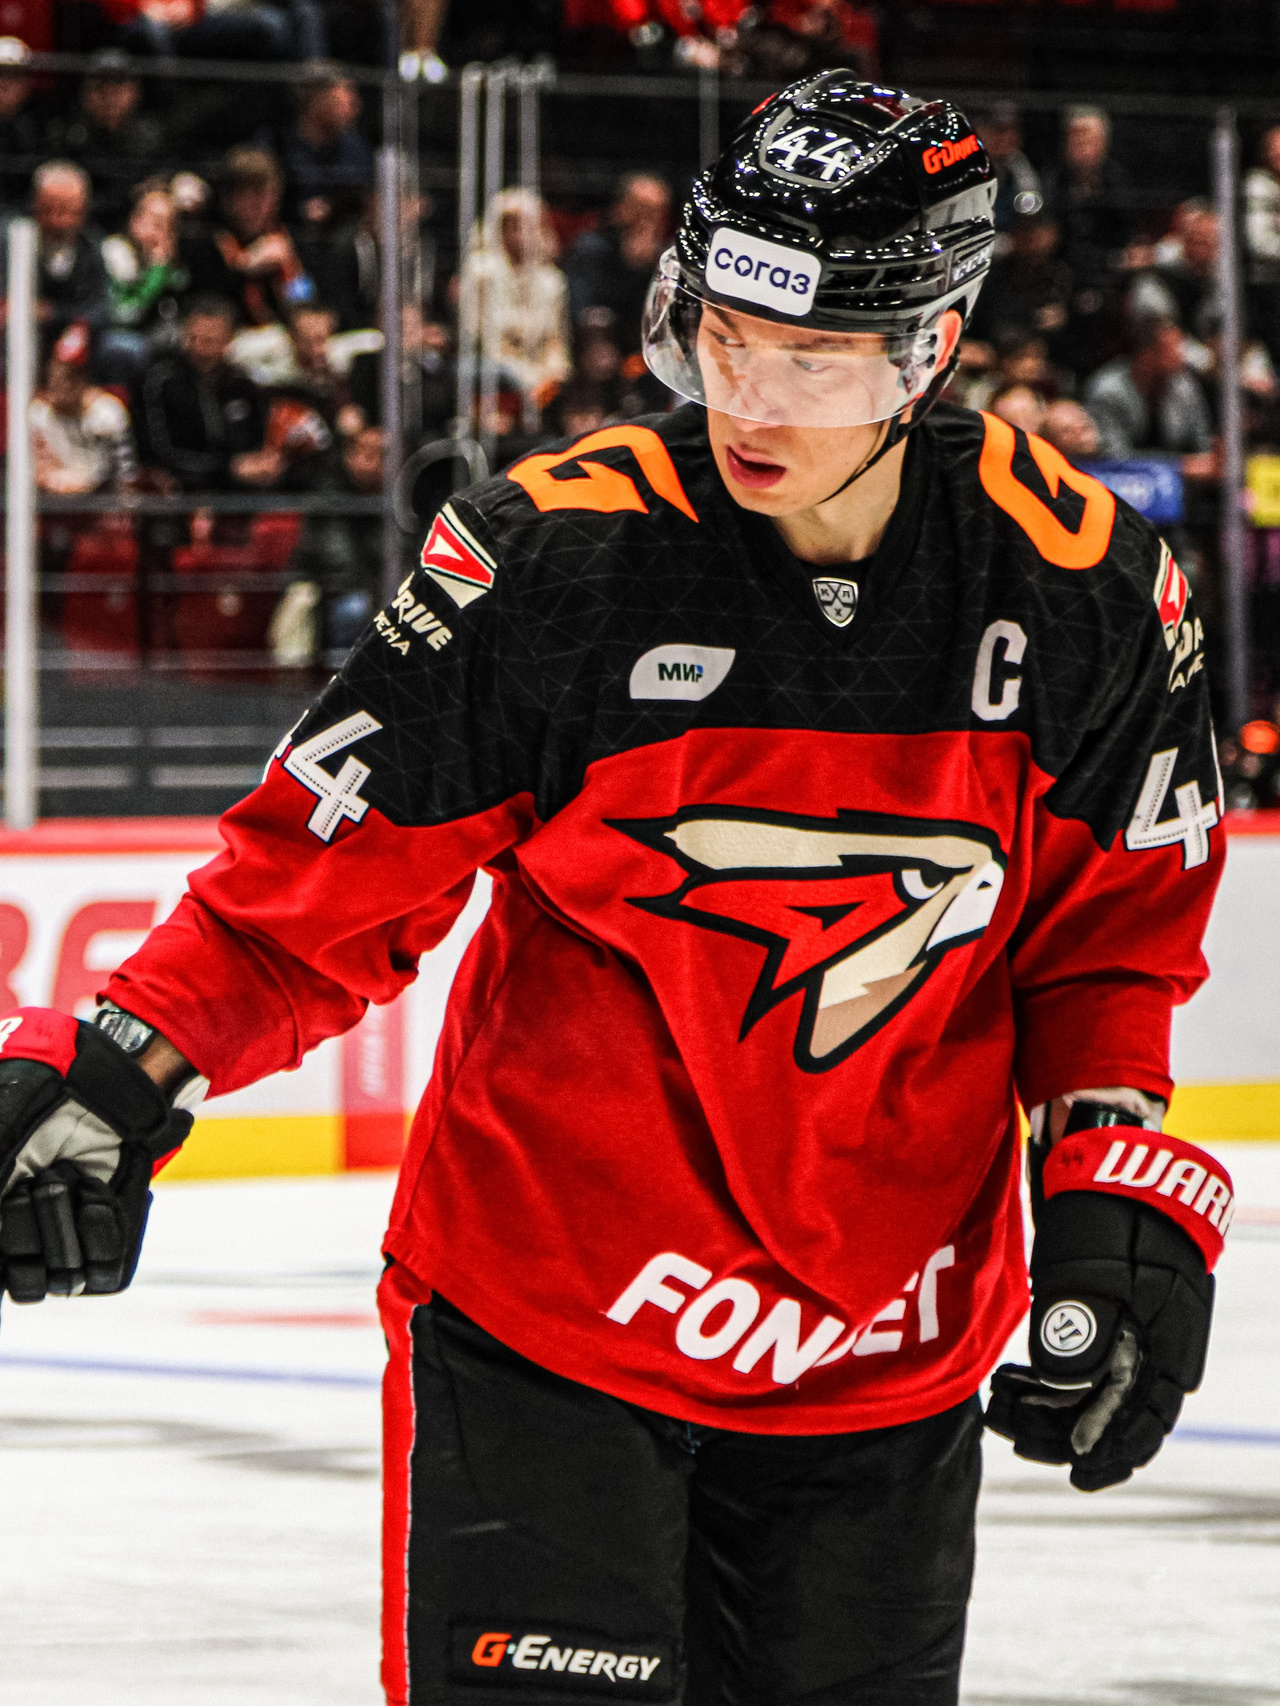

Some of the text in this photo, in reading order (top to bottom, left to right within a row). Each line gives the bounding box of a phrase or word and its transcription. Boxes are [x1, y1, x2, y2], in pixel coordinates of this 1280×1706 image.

[768, 125, 854, 181] 44
[713, 246, 811, 296] согаз
[658, 663, 704, 683] МИР
[971, 619, 1028, 721] C
[270, 710, 384, 843] 4
[1126, 747, 1221, 871] 4
[606, 1244, 956, 1385] FONET
